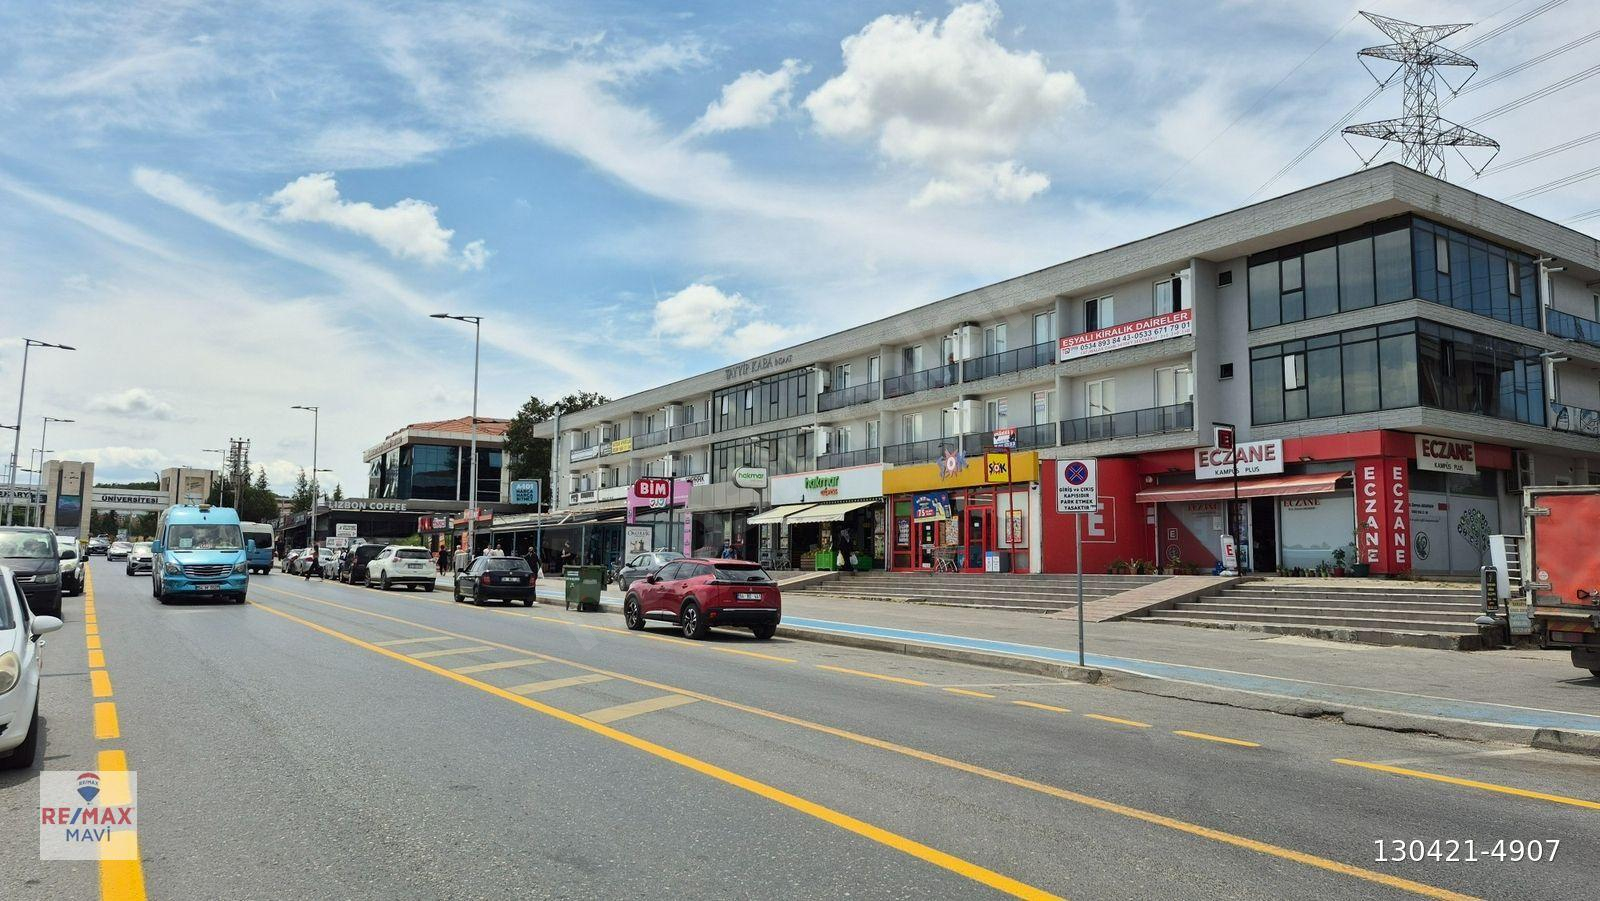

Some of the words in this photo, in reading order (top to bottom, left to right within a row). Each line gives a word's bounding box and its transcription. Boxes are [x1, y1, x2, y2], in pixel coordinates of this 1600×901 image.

[1062, 335, 1093, 347] EŞYALI
[1095, 324, 1133, 339] KİRALIK
[1136, 312, 1188, 329] DAİRELER
[1154, 327, 1167, 336] 671
[1181, 321, 1190, 329] 01
[1199, 443, 1276, 468] ECZANE
[1422, 439, 1474, 461] ECZANE
[738, 472, 764, 480] hakmar
[805, 476, 839, 489] hakmar
[640, 480, 667, 496] BİM
[101, 494, 159, 505] ÜNİVERSİTESİ
[328, 500, 367, 510] LIZBON
[369, 501, 407, 511] COFFEE
[1364, 466, 1379, 563] ECZANE
[1393, 466, 1406, 563] ECZANE
[1226, 544, 1234, 556] E
